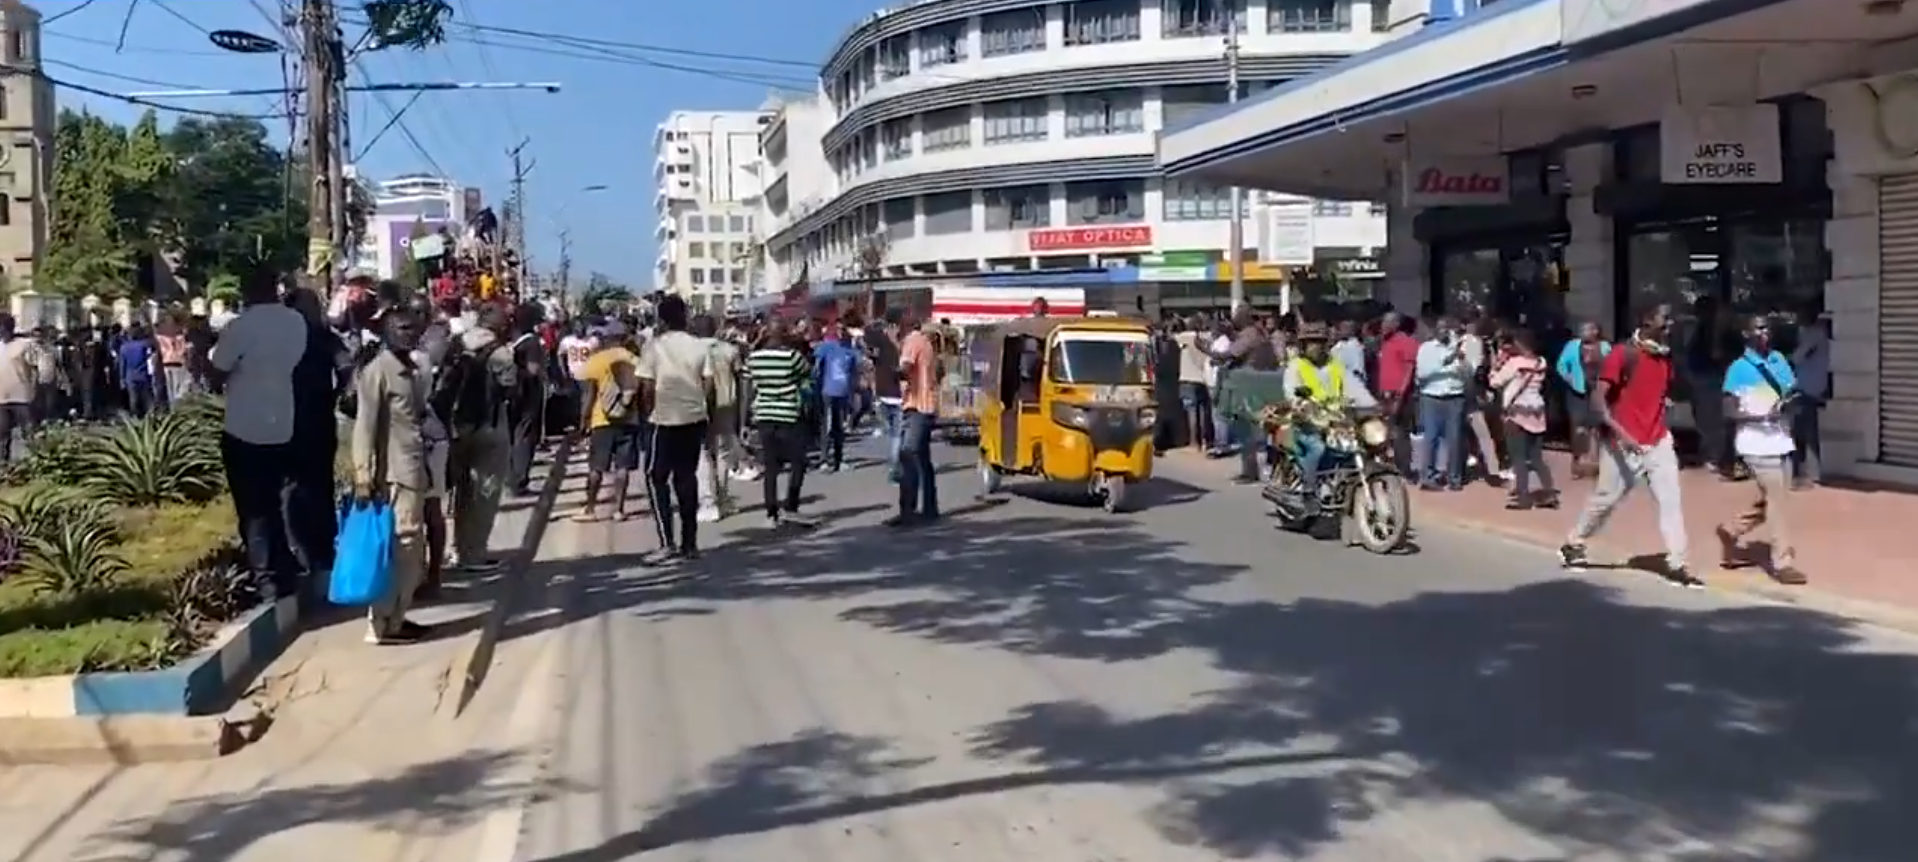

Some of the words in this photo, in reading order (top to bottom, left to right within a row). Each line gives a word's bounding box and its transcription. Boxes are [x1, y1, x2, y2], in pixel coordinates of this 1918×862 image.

[1694, 142, 1745, 158] JAFF'S
[1685, 162, 1757, 178] EYECARE
[1414, 167, 1502, 193] Bata
